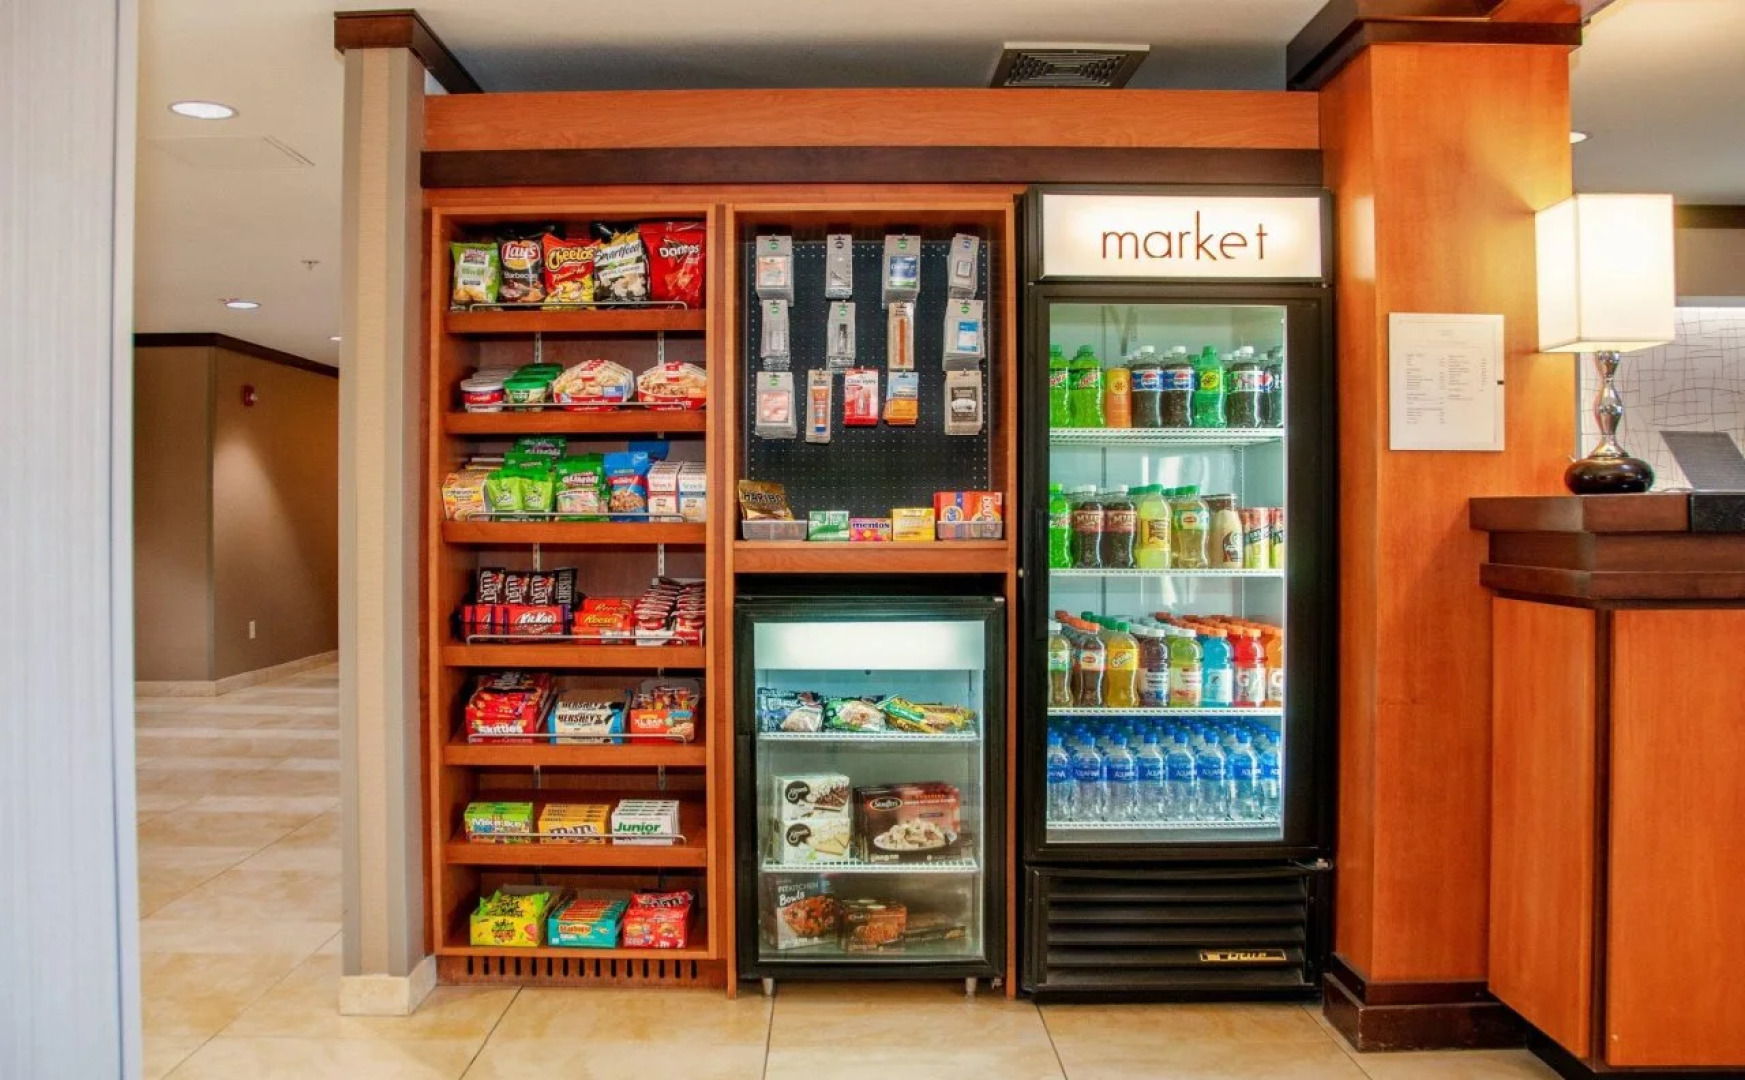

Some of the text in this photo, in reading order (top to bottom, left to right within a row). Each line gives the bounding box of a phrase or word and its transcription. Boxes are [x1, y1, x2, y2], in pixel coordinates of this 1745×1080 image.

[1102, 211, 1268, 260] market
[546, 248, 594, 271] Cheetos
[659, 244, 699, 258] Doritos
[614, 821, 661, 833] Junior
